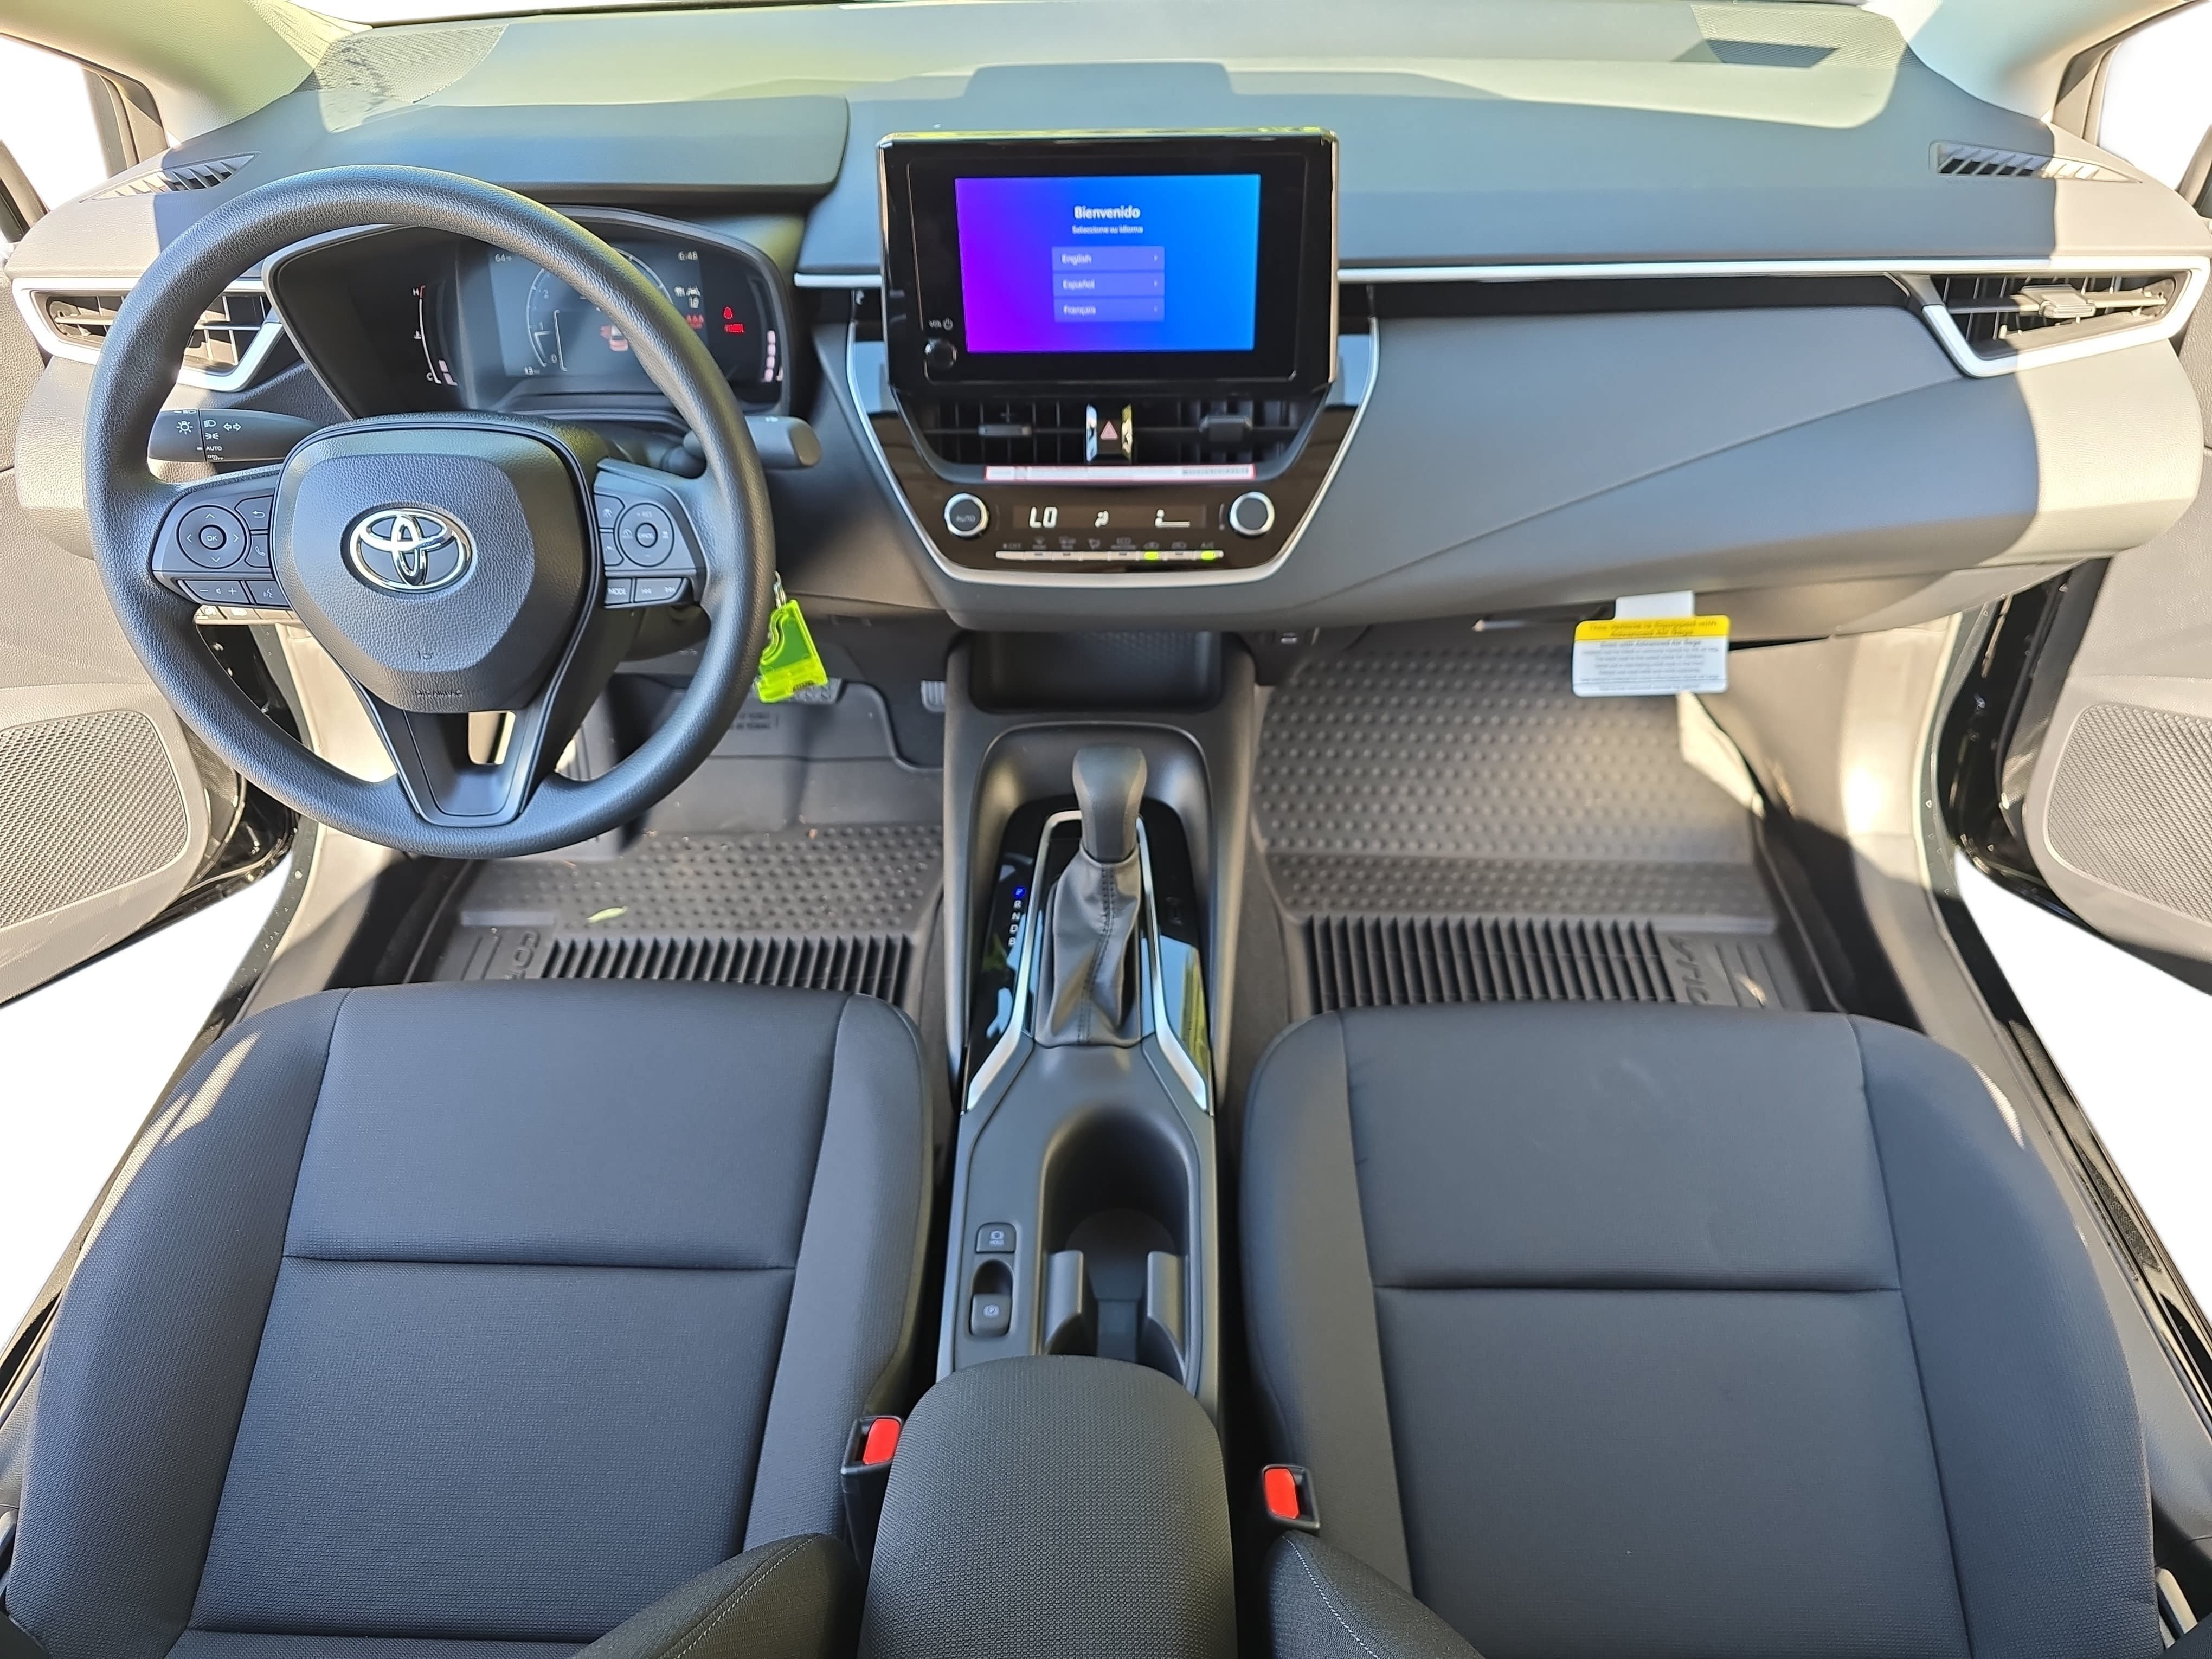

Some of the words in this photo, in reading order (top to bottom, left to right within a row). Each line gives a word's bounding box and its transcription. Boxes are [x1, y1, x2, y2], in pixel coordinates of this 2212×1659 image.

[1073, 205, 1141, 219] Bienvenido
[1061, 254, 1092, 265] English
[1062, 279, 1095, 290] Español
[413, 288, 420, 296] H
[1063, 305, 1097, 316] Français
[1029, 506, 1058, 528] LO
[1013, 900, 1021, 908] R
[1011, 912, 1020, 921] N
[1009, 924, 1018, 933] D
